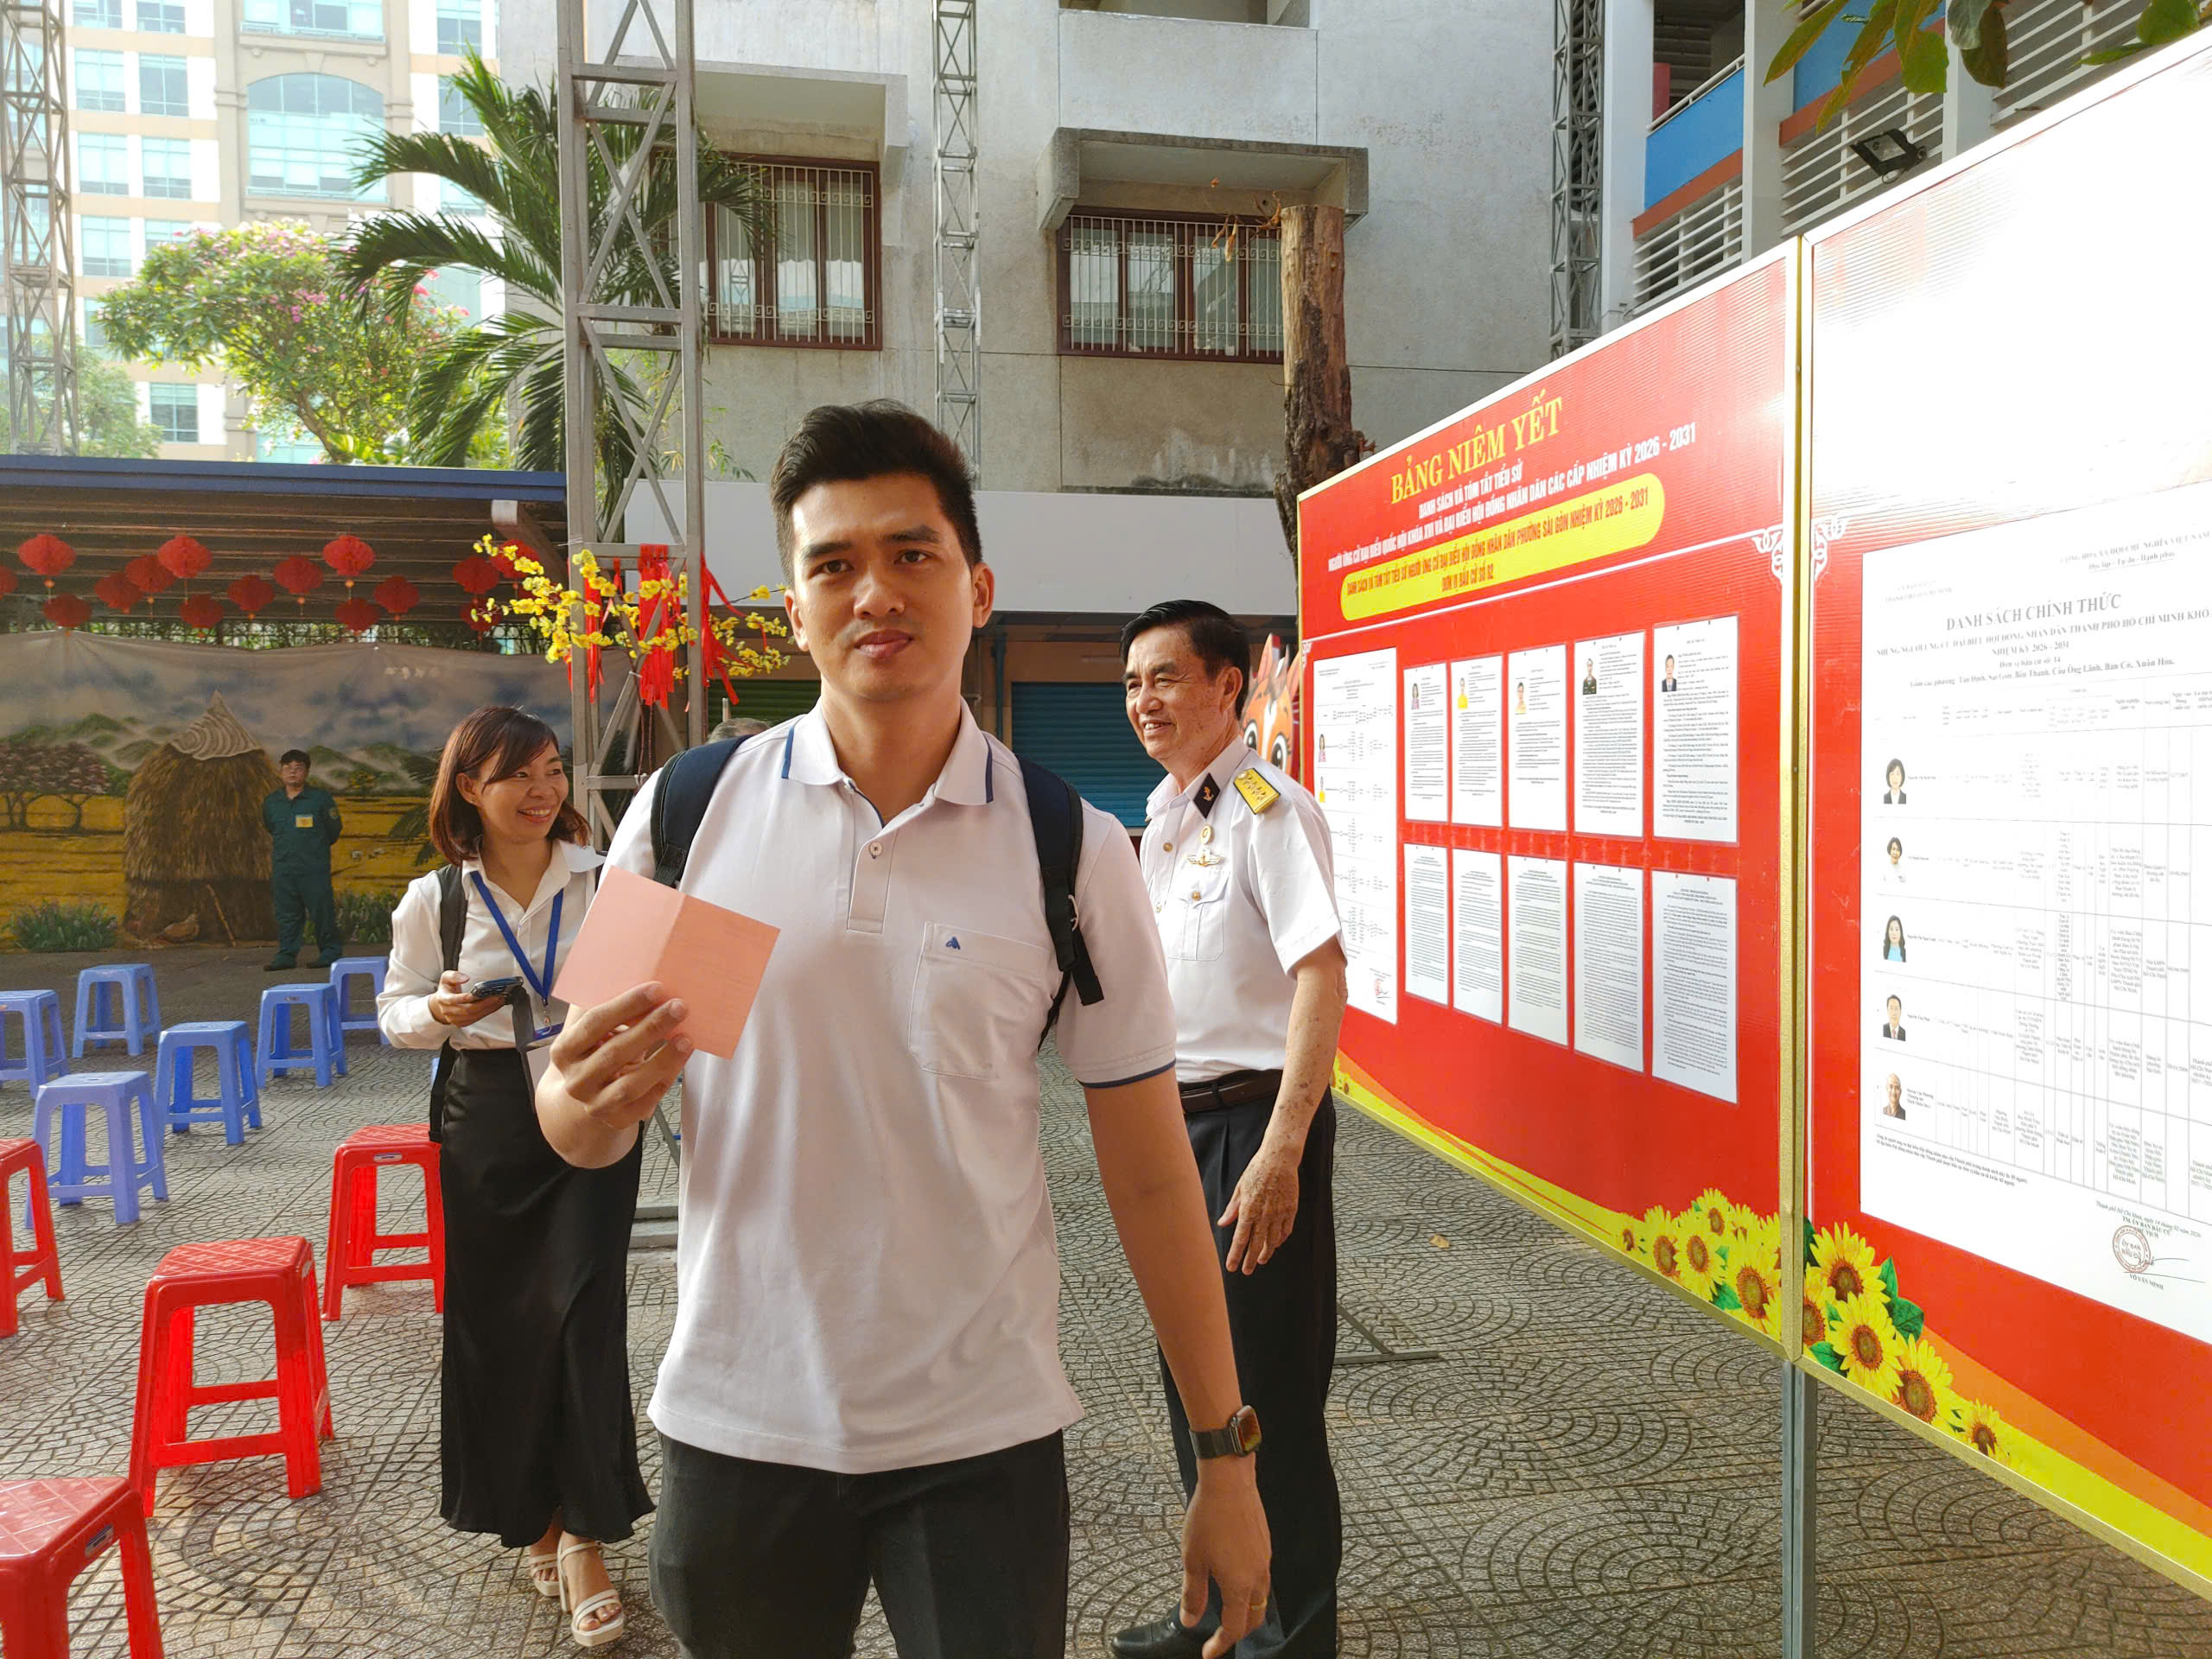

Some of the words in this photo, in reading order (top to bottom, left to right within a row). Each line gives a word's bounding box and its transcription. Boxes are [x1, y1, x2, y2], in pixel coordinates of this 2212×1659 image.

[1391, 454, 1444, 505] BẢNG
[1447, 423, 1507, 480] NIÊM
[1511, 388, 1563, 452] YẾT
[1418, 499, 1435, 519] DANH
[1436, 492, 1454, 513] SÁCH
[1454, 485, 1464, 505] VÀ
[1464, 480, 1480, 502] TÓM
[1479, 471, 1493, 499] TẮT
[1494, 463, 1510, 495] TIỂU
[1511, 458, 1523, 484] SỬ
[1434, 517, 1444, 537] VÀ
[1443, 516, 1455, 535] ĐẠI
[1455, 503, 1472, 530] BIỂU
[1471, 501, 1485, 524] HỘI
[1484, 493, 1506, 519] ĐỒNG
[1506, 485, 1529, 512] NHÂN
[1529, 478, 1548, 502] DÂN
[1548, 472, 1566, 495] CÁC
[1567, 460, 1585, 488] CẤP
[1586, 452, 1618, 481] NHIỆM
[1619, 442, 1633, 469] KỲ
[1635, 435, 1661, 464] 2026
[1669, 421, 1696, 451] 2031
[1503, 529, 1516, 550] DÂN
[1516, 521, 1541, 546] PHƯỜNG
[1542, 516, 1554, 537] SÀI
[1555, 511, 1569, 534] GÒN
[1570, 504, 1592, 530] NHIỆM
[1594, 498, 1604, 522] KỲ
[1605, 495, 1624, 518] 2026
[1630, 486, 1649, 510] 2031
[1947, 613, 1983, 632] DANH
[1986, 607, 2023, 626] SÁCH
[2025, 600, 2073, 620] CHÍNH
[2076, 591, 2123, 613] THỨC
[2031, 642, 2048, 652] 2026
[2148, 1281, 2164, 1291] MINH
